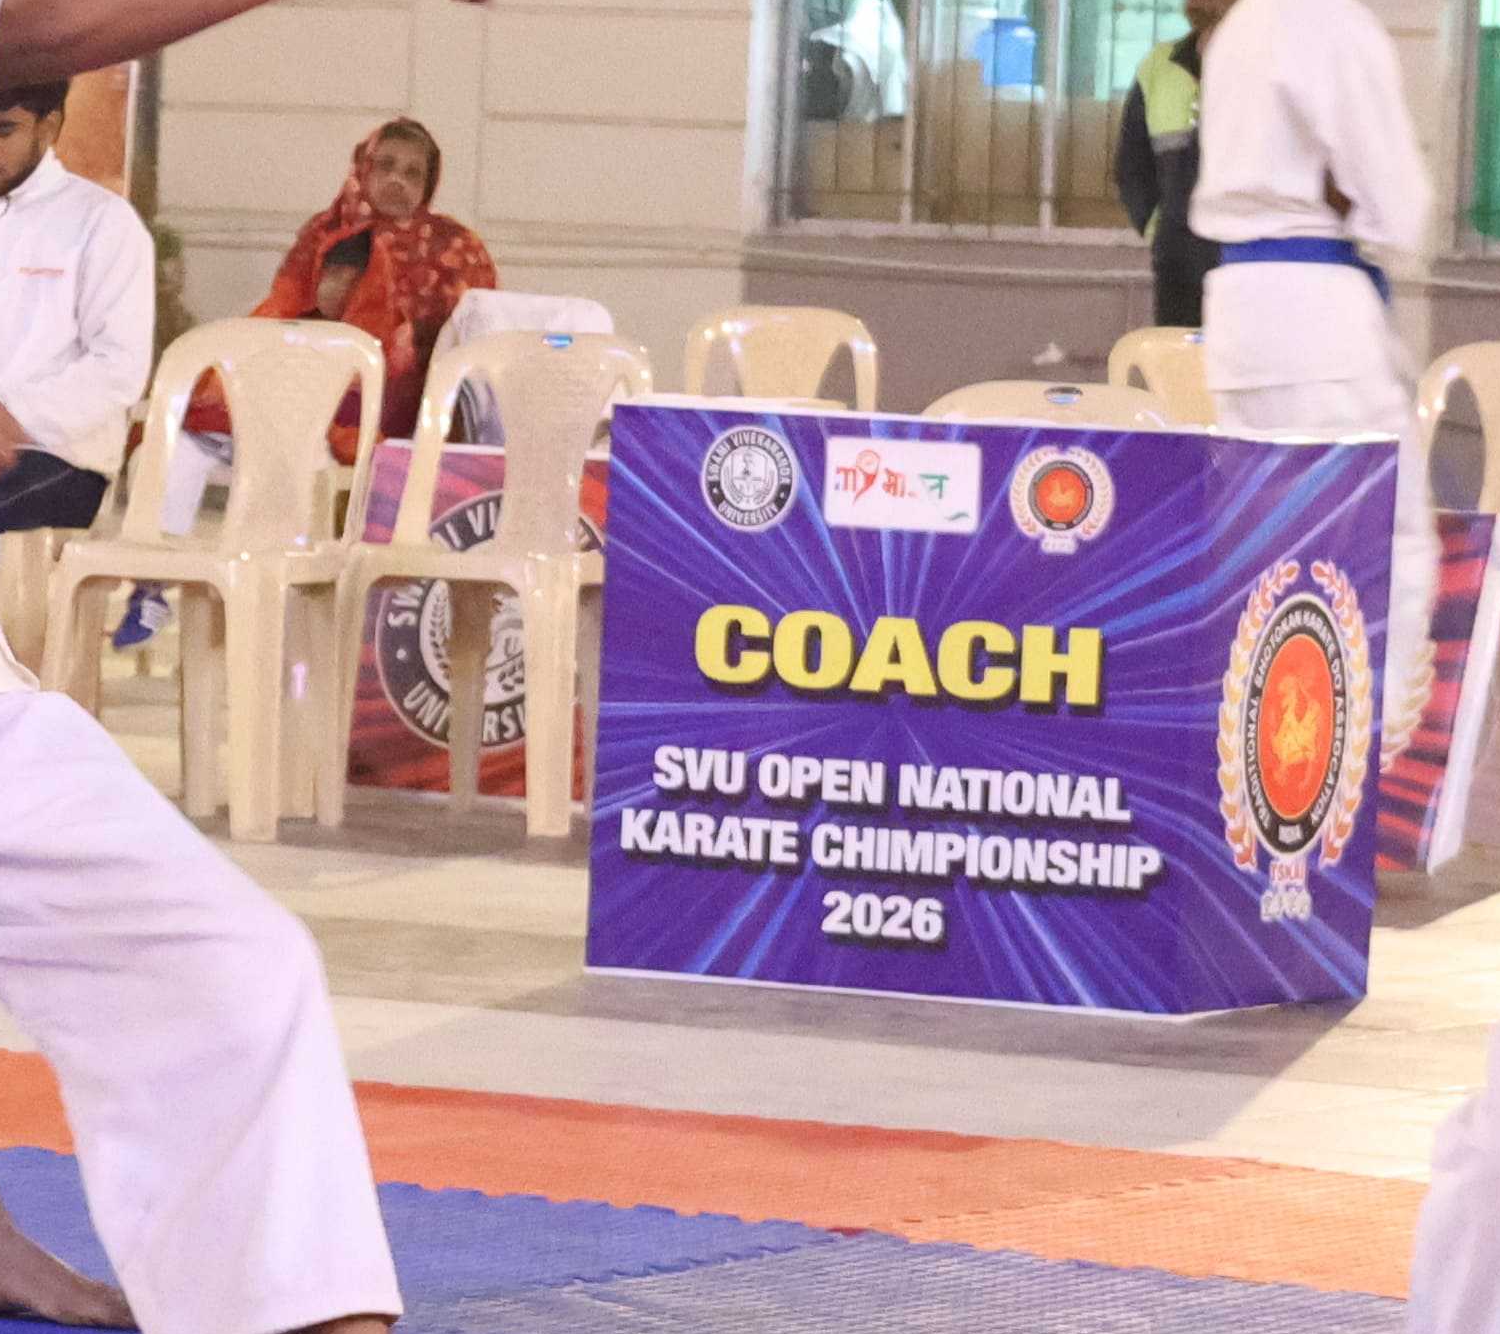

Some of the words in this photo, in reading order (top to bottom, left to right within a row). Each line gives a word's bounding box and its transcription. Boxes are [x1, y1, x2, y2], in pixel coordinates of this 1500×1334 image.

[695, 604, 1102, 705] COACH
[1254, 611, 1303, 688] SHOTOKAN
[653, 744, 746, 795] SVU
[758, 753, 886, 805] OPEN
[898, 763, 1132, 823] NATIONAL
[1247, 696, 1270, 830] TRADITIONAL
[620, 807, 799, 864] KARATE
[811, 823, 1162, 890] CHIMPIONSHIP
[821, 890, 944, 941] 2026
